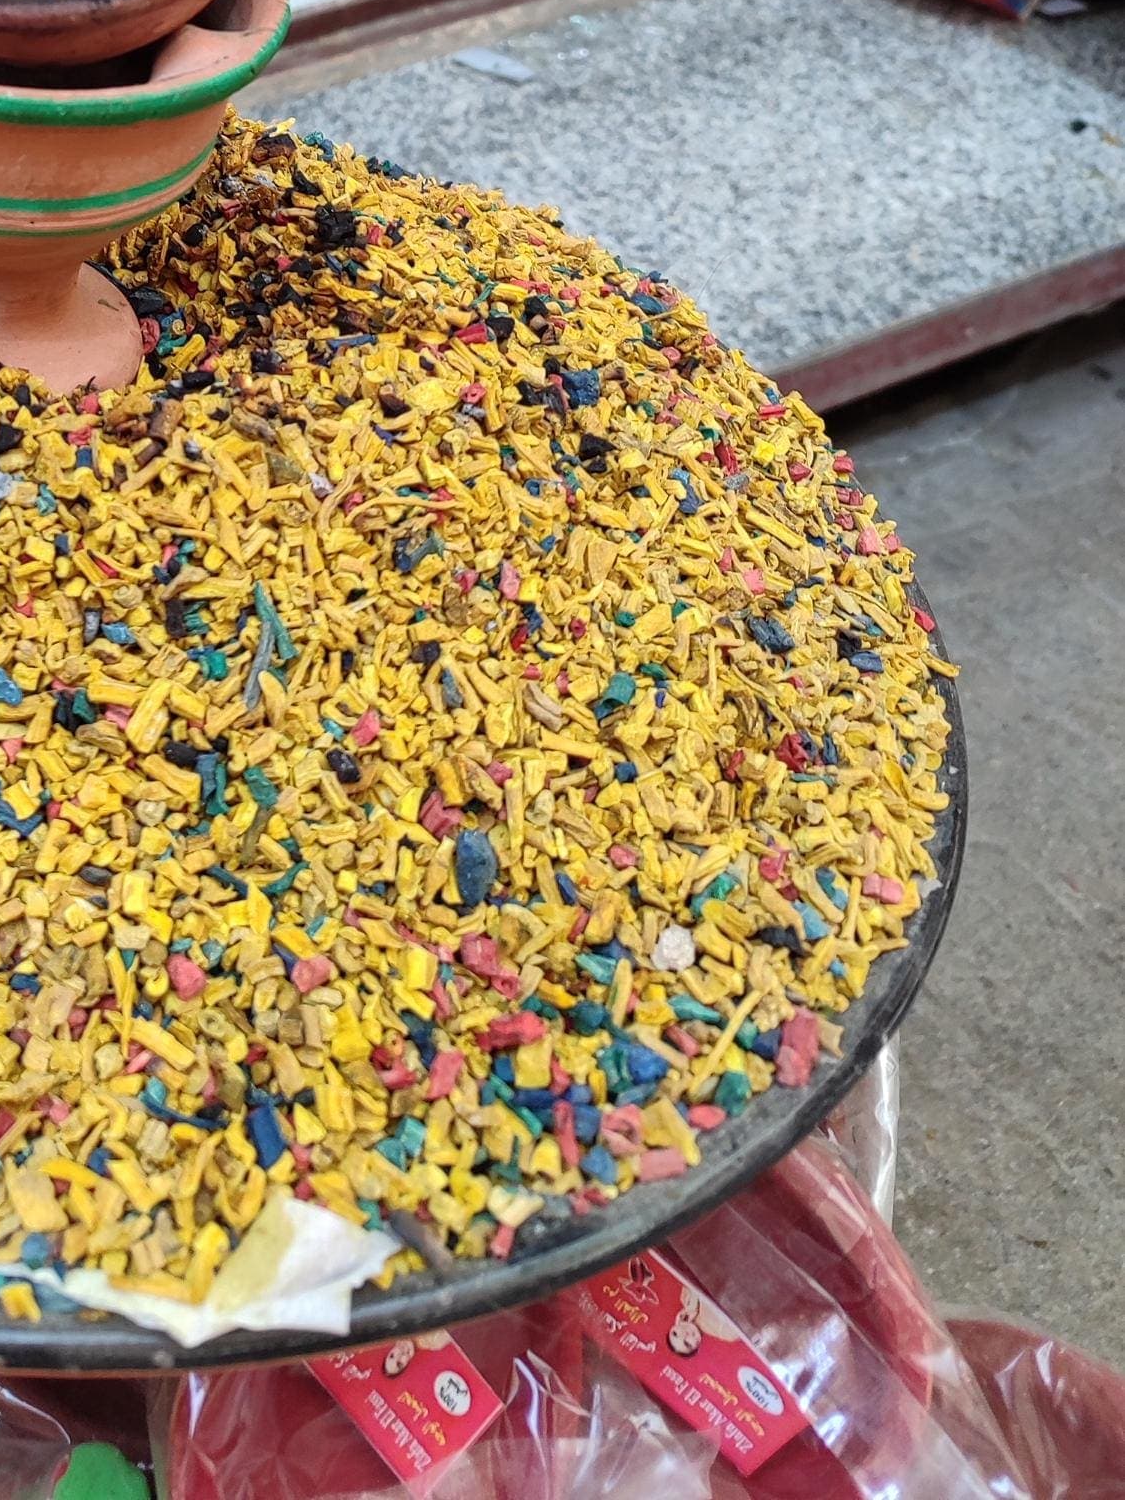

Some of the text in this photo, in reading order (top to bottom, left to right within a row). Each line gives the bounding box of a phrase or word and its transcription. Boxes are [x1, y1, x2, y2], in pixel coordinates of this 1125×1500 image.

[659, 1364, 688, 1395] Fassi
[683, 1385, 702, 1403] El
[747, 1380, 770, 1409] 100%
[700, 1398, 729, 1428] Akar
